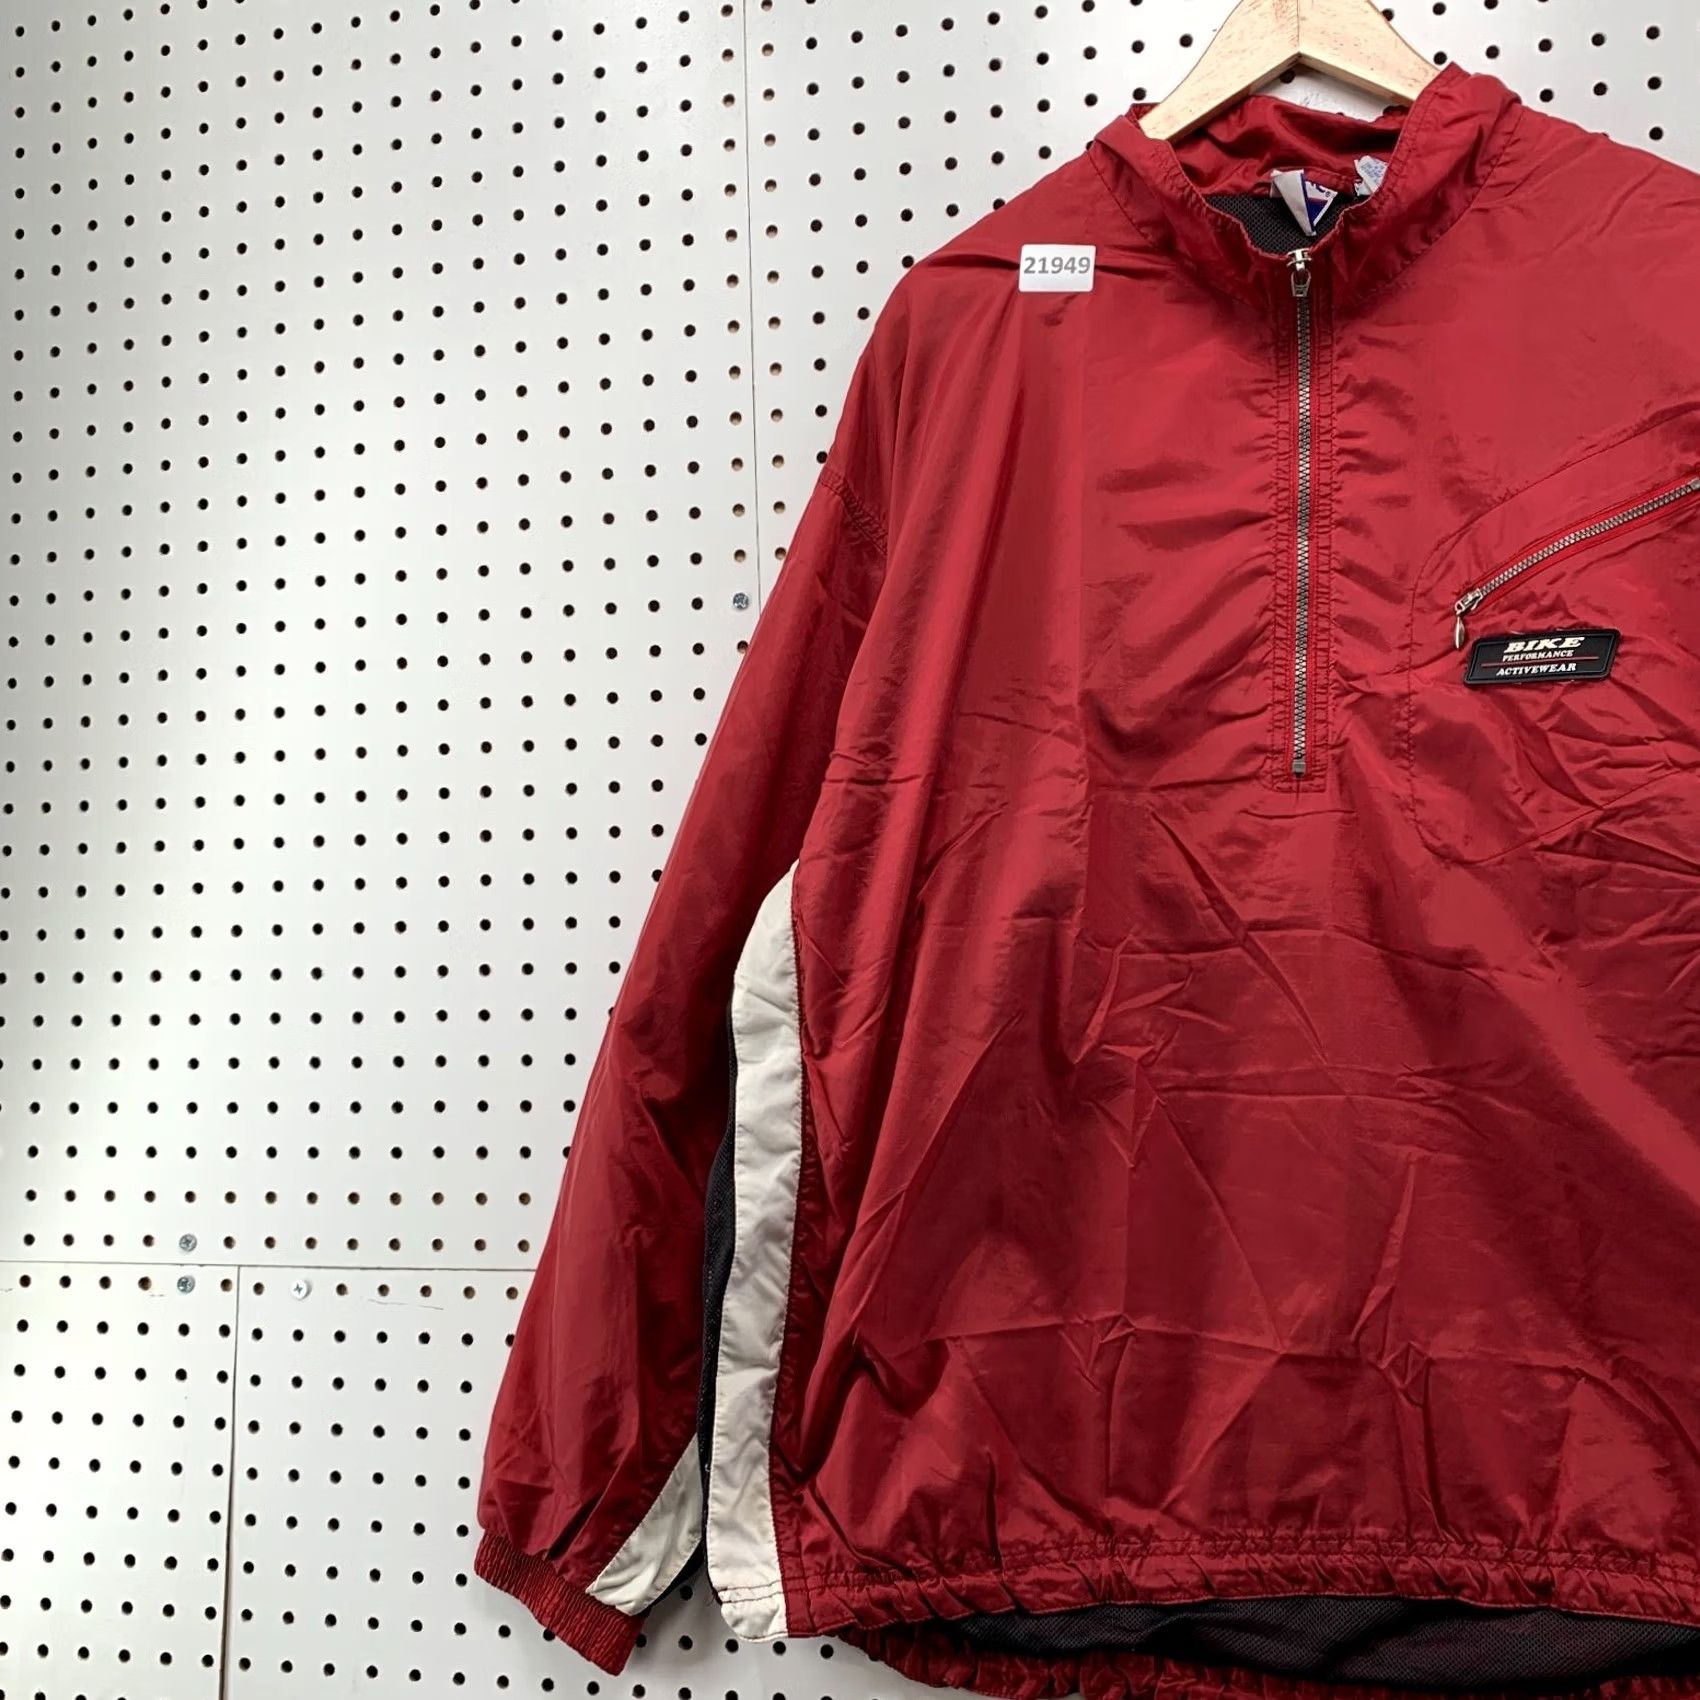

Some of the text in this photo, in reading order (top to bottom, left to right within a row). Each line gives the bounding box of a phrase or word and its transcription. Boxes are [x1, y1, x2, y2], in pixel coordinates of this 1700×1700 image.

[1023, 256, 1091, 275] 21949
[1504, 637, 1585, 653] BIKE
[1502, 650, 1574, 662] PERFORMANCE
[1496, 663, 1577, 676] ACTIVEWEAR
